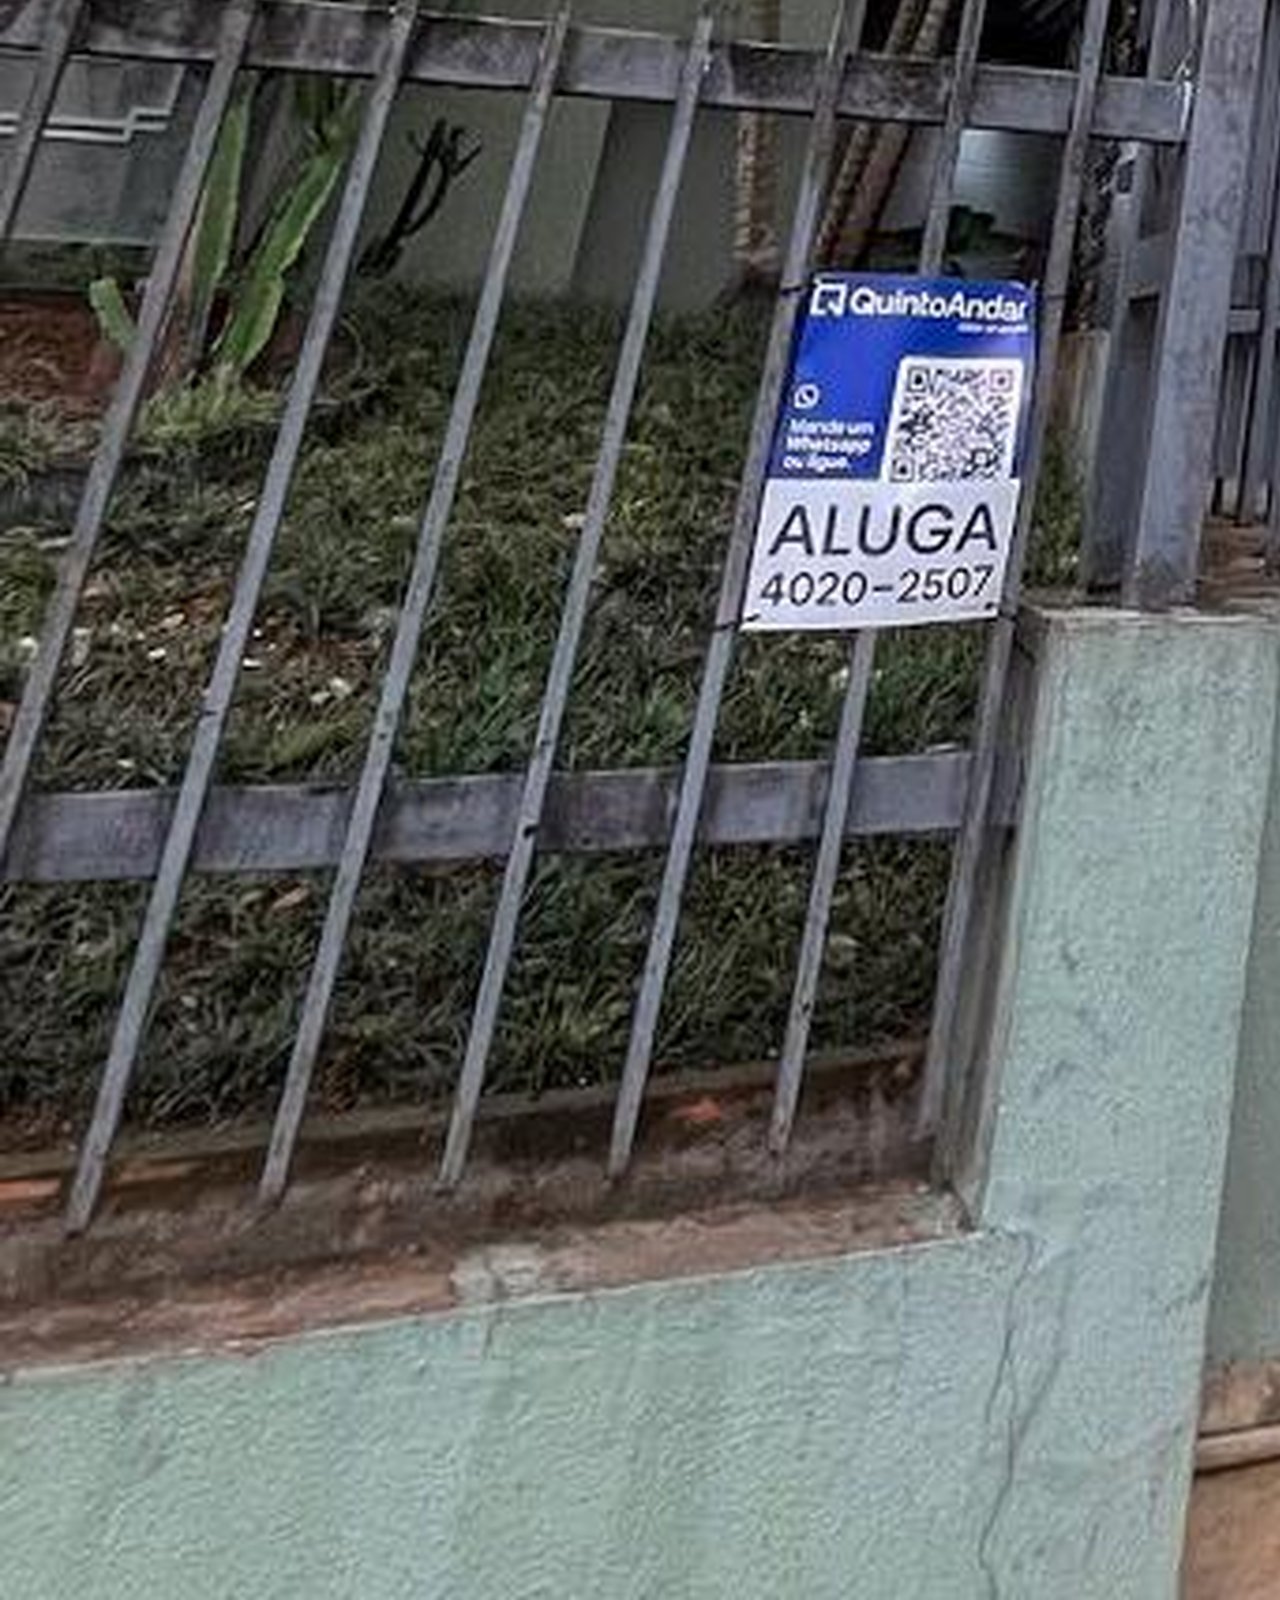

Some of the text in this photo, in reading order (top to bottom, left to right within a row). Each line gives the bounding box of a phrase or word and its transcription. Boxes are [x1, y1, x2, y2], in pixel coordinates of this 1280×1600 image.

[850, 287, 1028, 323] QuintoAndar
[768, 502, 998, 557] ALUGA
[760, 565, 994, 607] 4020-2507
